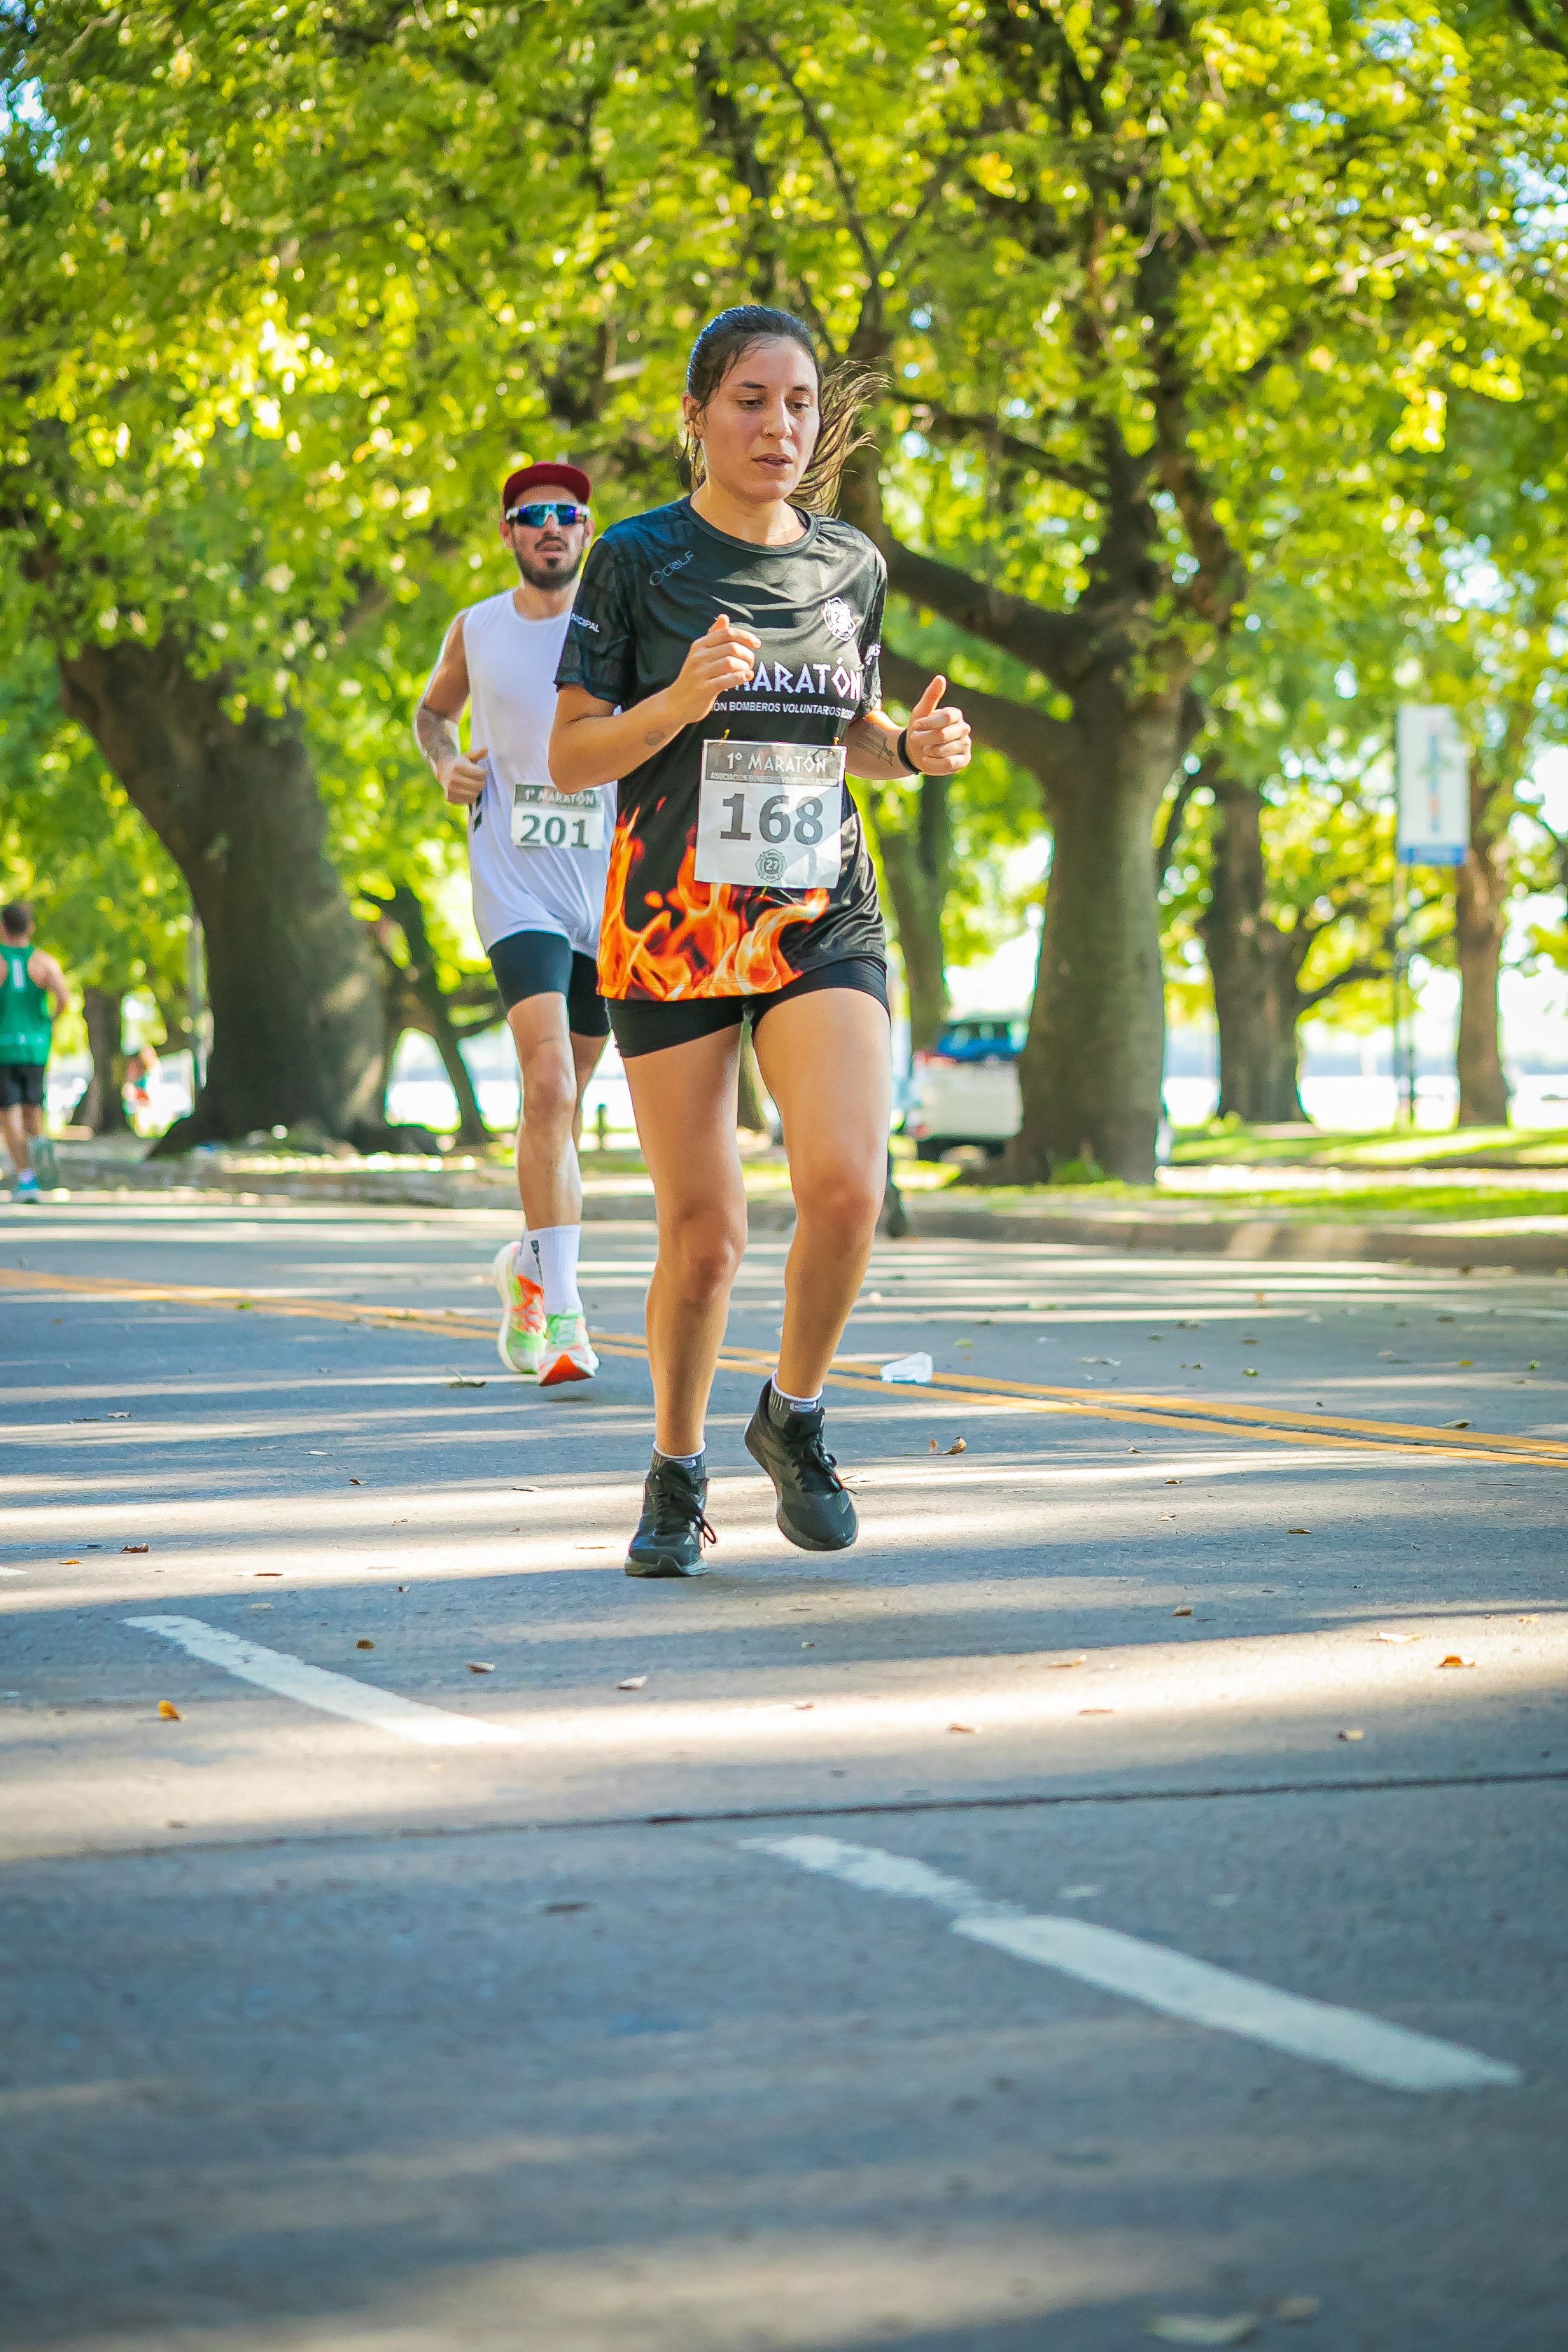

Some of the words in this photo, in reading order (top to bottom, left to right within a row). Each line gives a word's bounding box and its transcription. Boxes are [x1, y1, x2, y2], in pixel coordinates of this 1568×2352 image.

[734, 656, 862, 700] ARATÓN
[729, 701, 780, 713] BOMBEROS
[783, 702, 841, 718] VOLUNTARIOS
[747, 750, 828, 774] MARATÓN
[520, 814, 589, 848] 201
[720, 793, 823, 846] 168
[765, 859, 779, 871] 27
